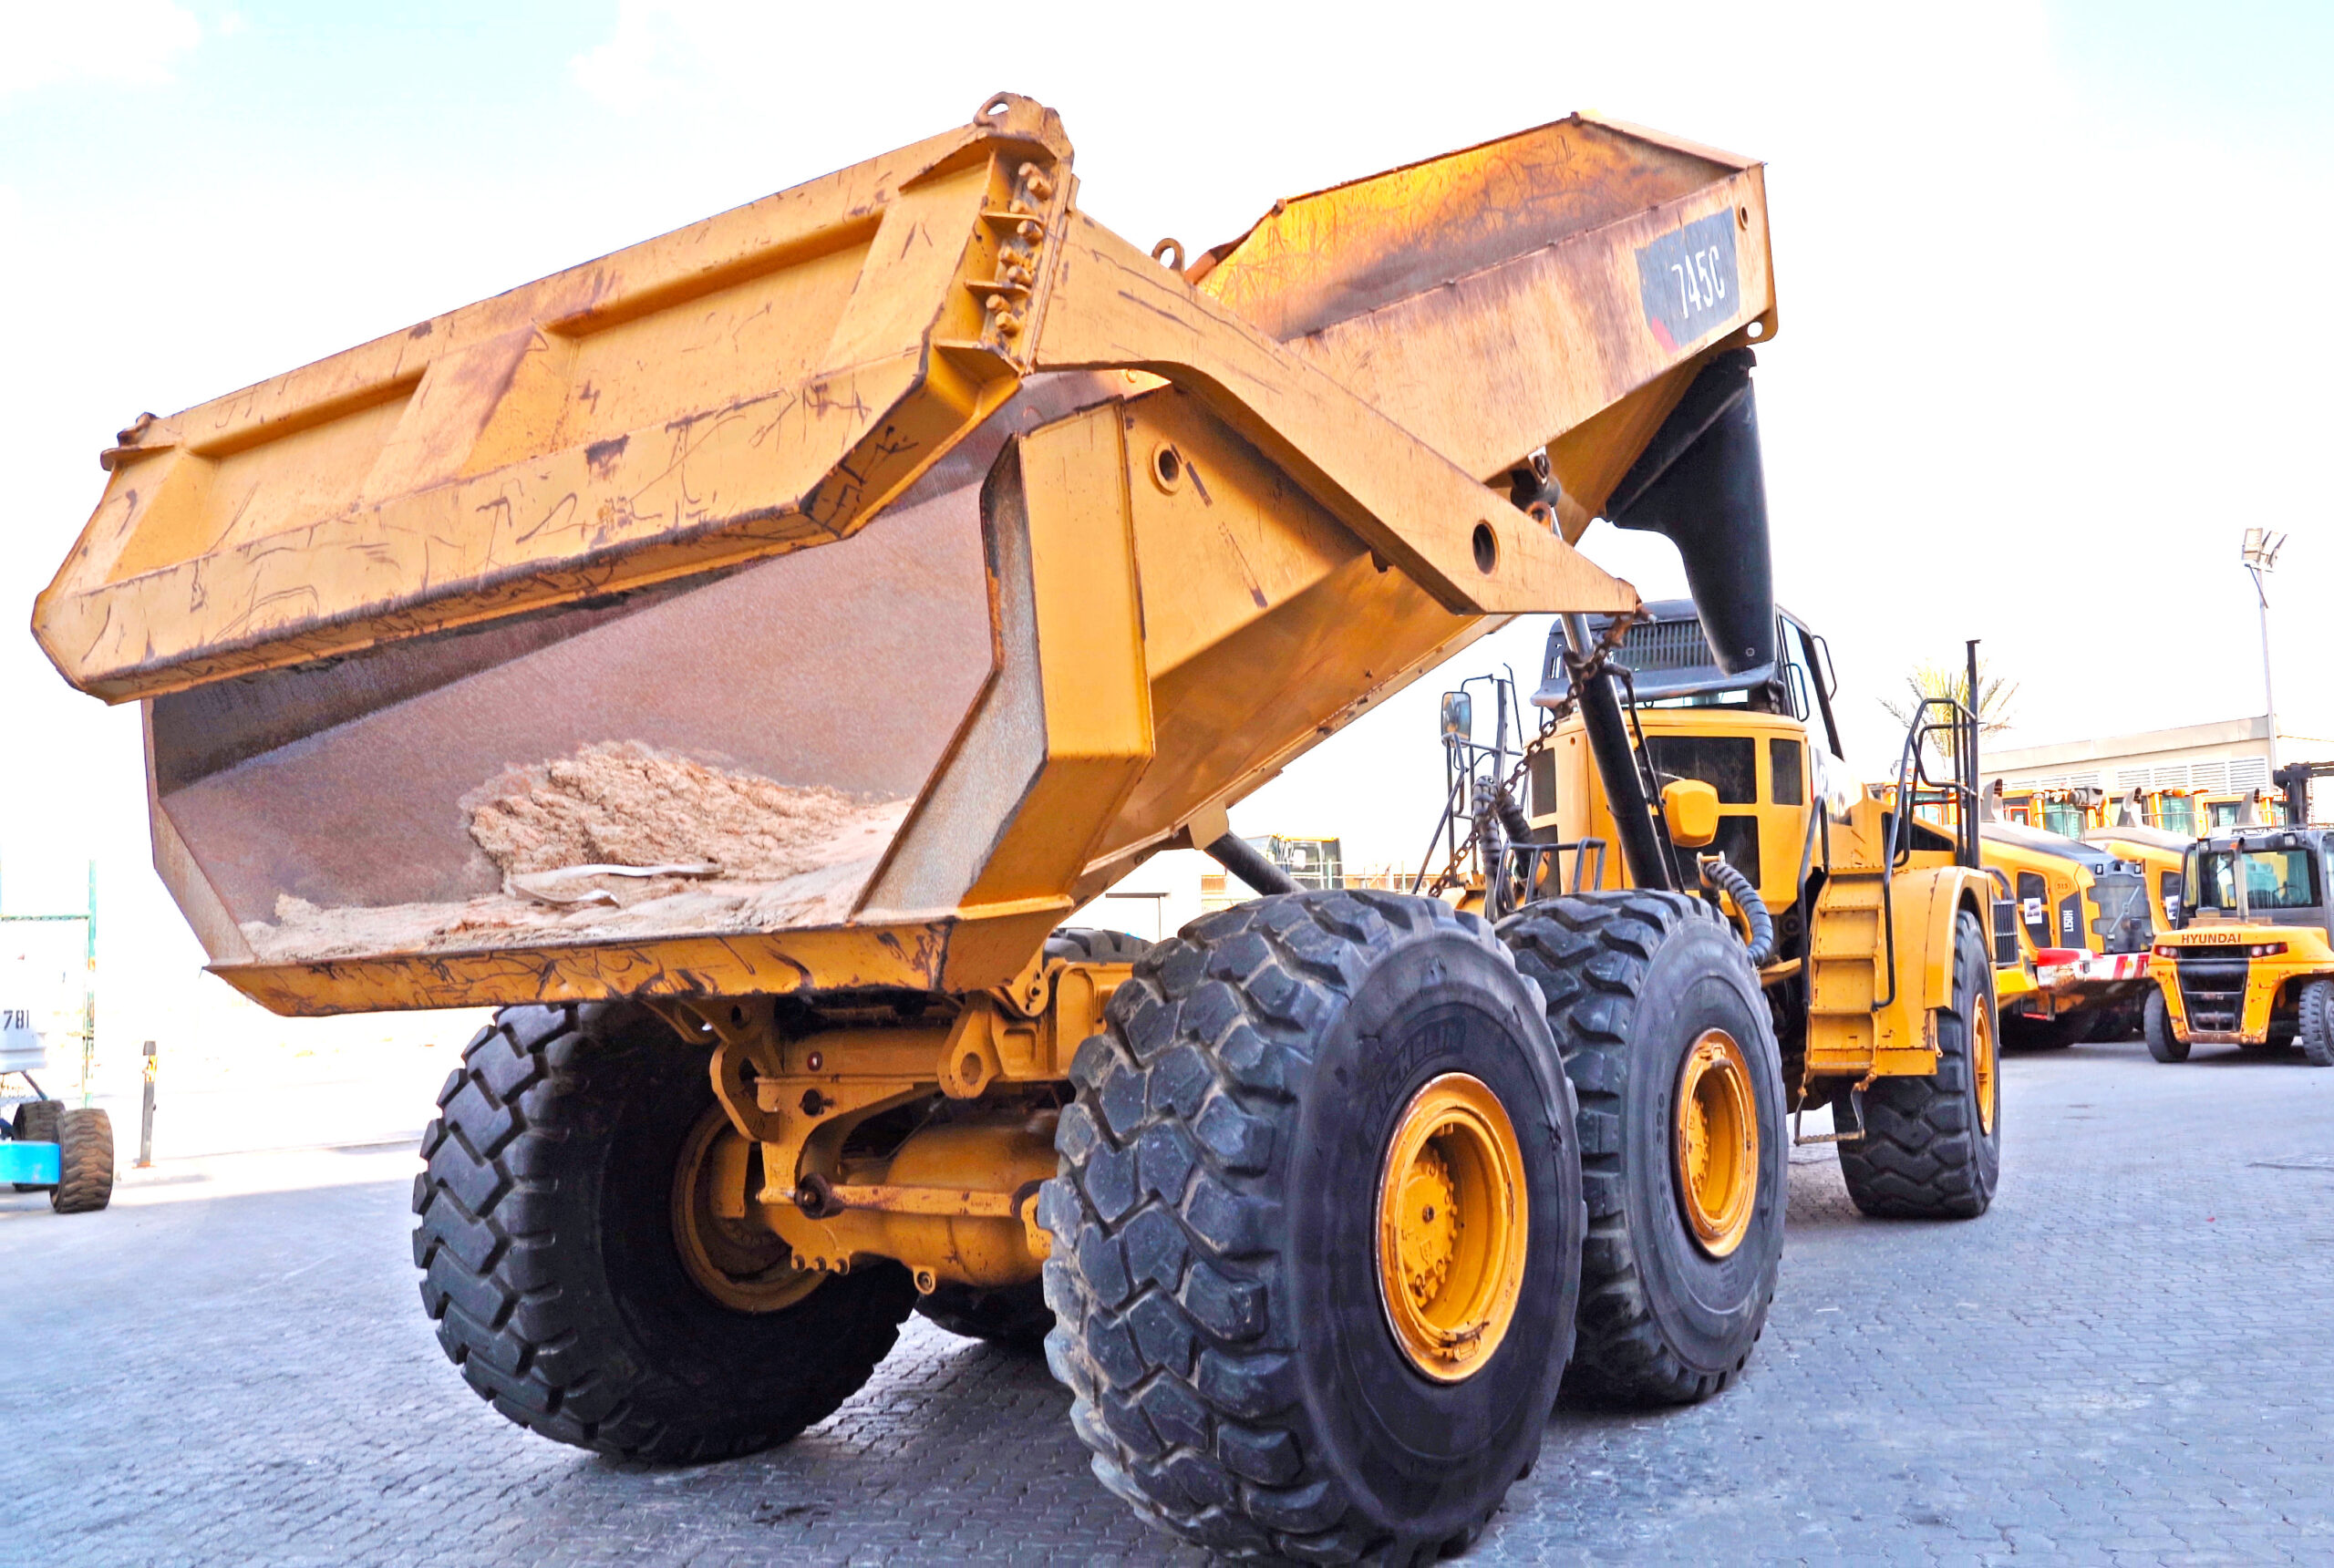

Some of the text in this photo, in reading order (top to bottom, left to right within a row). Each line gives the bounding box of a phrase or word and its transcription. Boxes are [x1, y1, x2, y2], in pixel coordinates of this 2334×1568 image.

[1671, 245, 1726, 319] 745C
[2062, 910, 2074, 932] L150H
[2181, 933, 2241, 944] HYUNDAI
